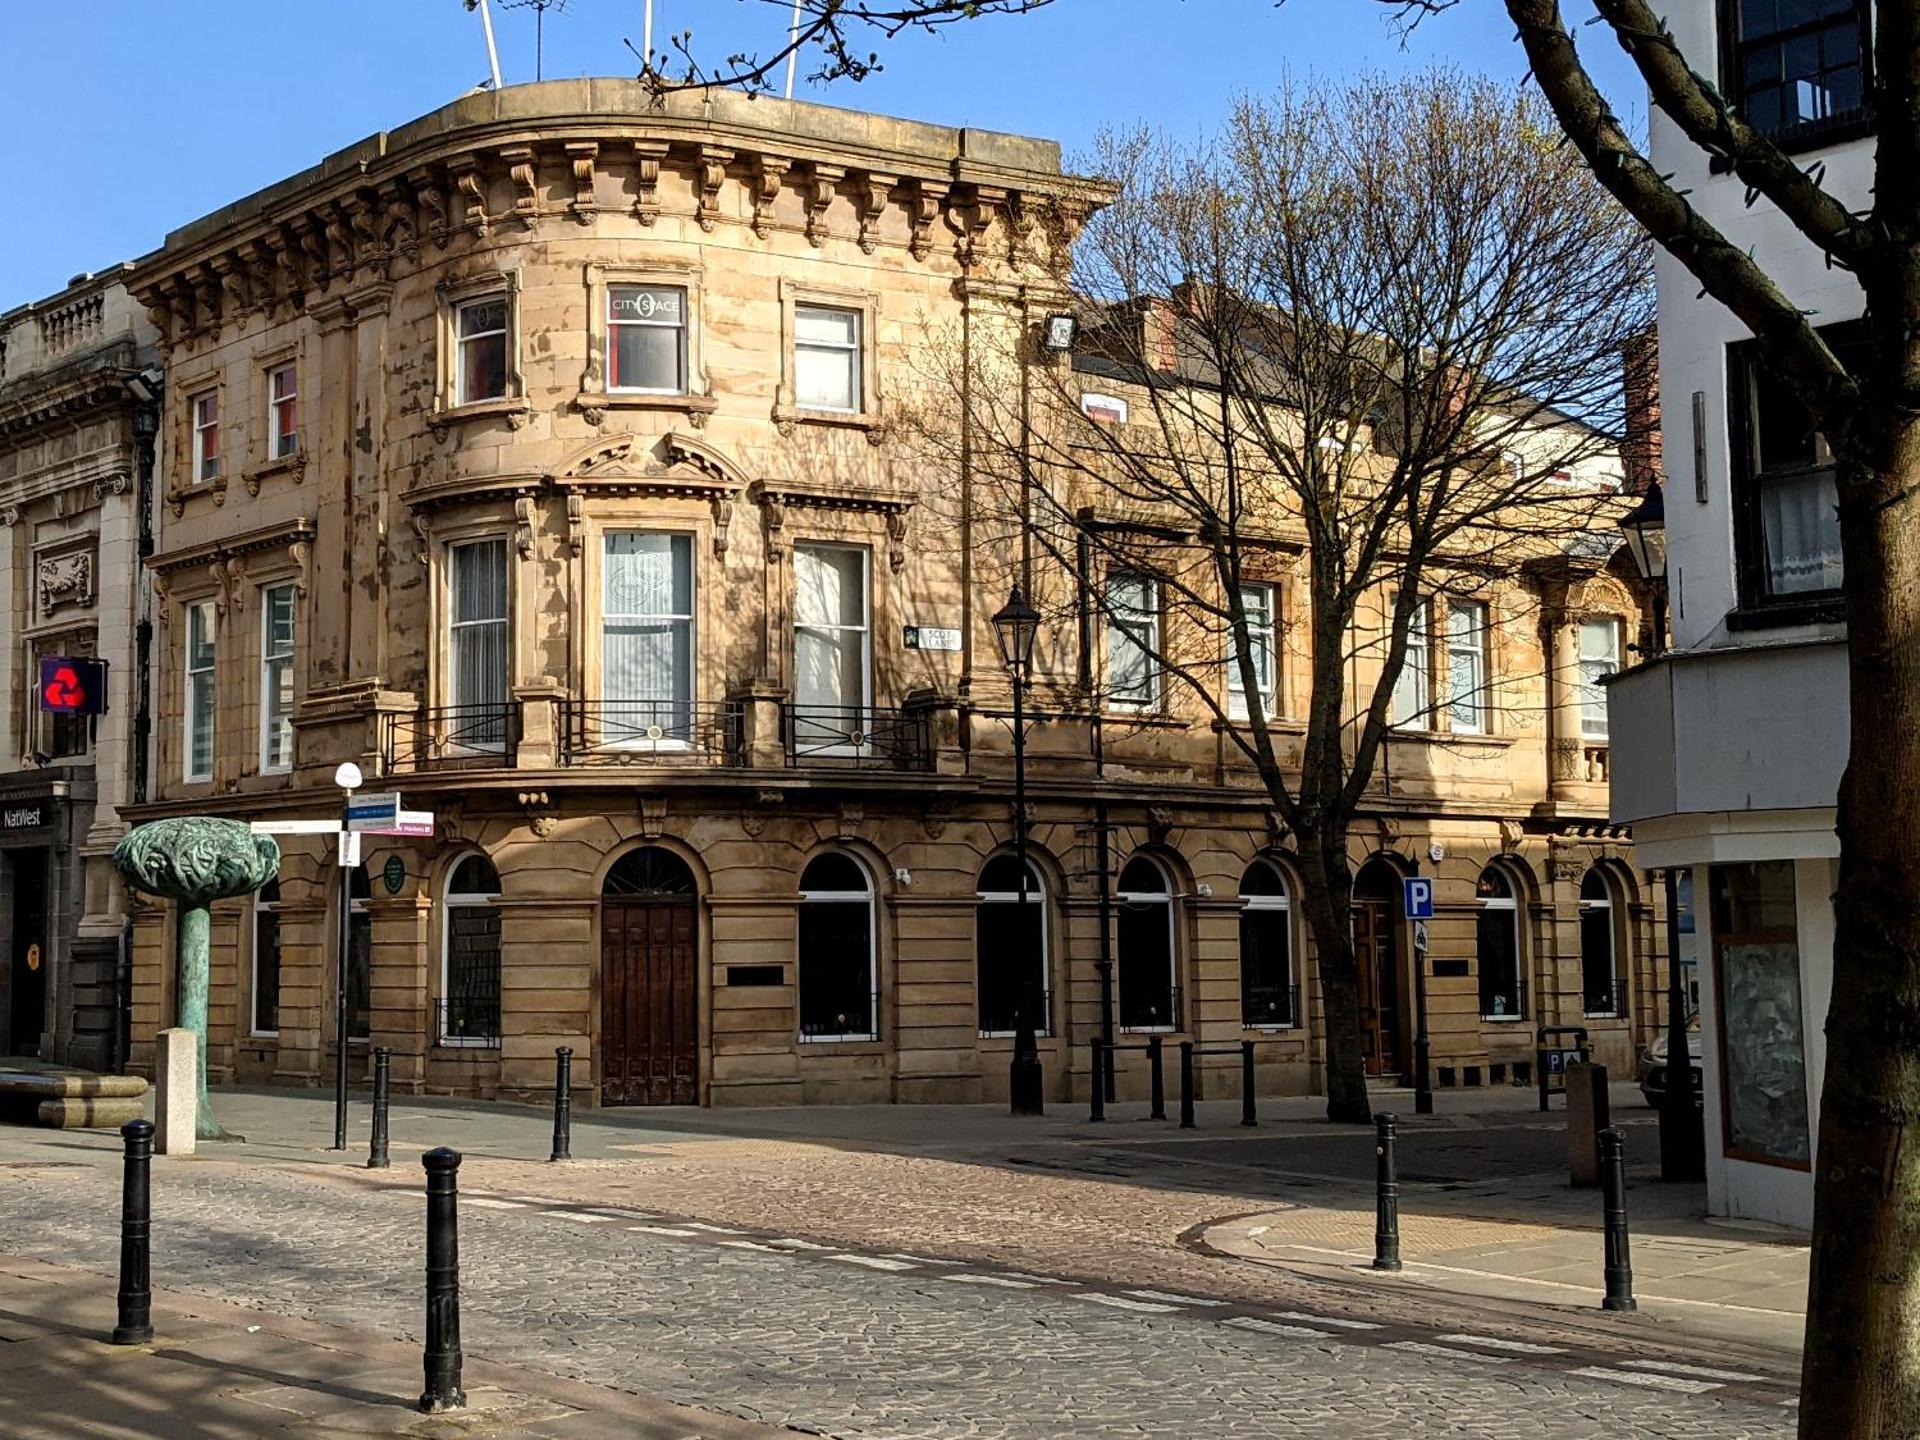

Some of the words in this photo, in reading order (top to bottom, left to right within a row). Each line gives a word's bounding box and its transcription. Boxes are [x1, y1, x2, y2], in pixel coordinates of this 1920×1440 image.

[4, 807, 41, 828] NatWest
[1411, 882, 1429, 915] P
[1551, 1054, 1559, 1070] P
